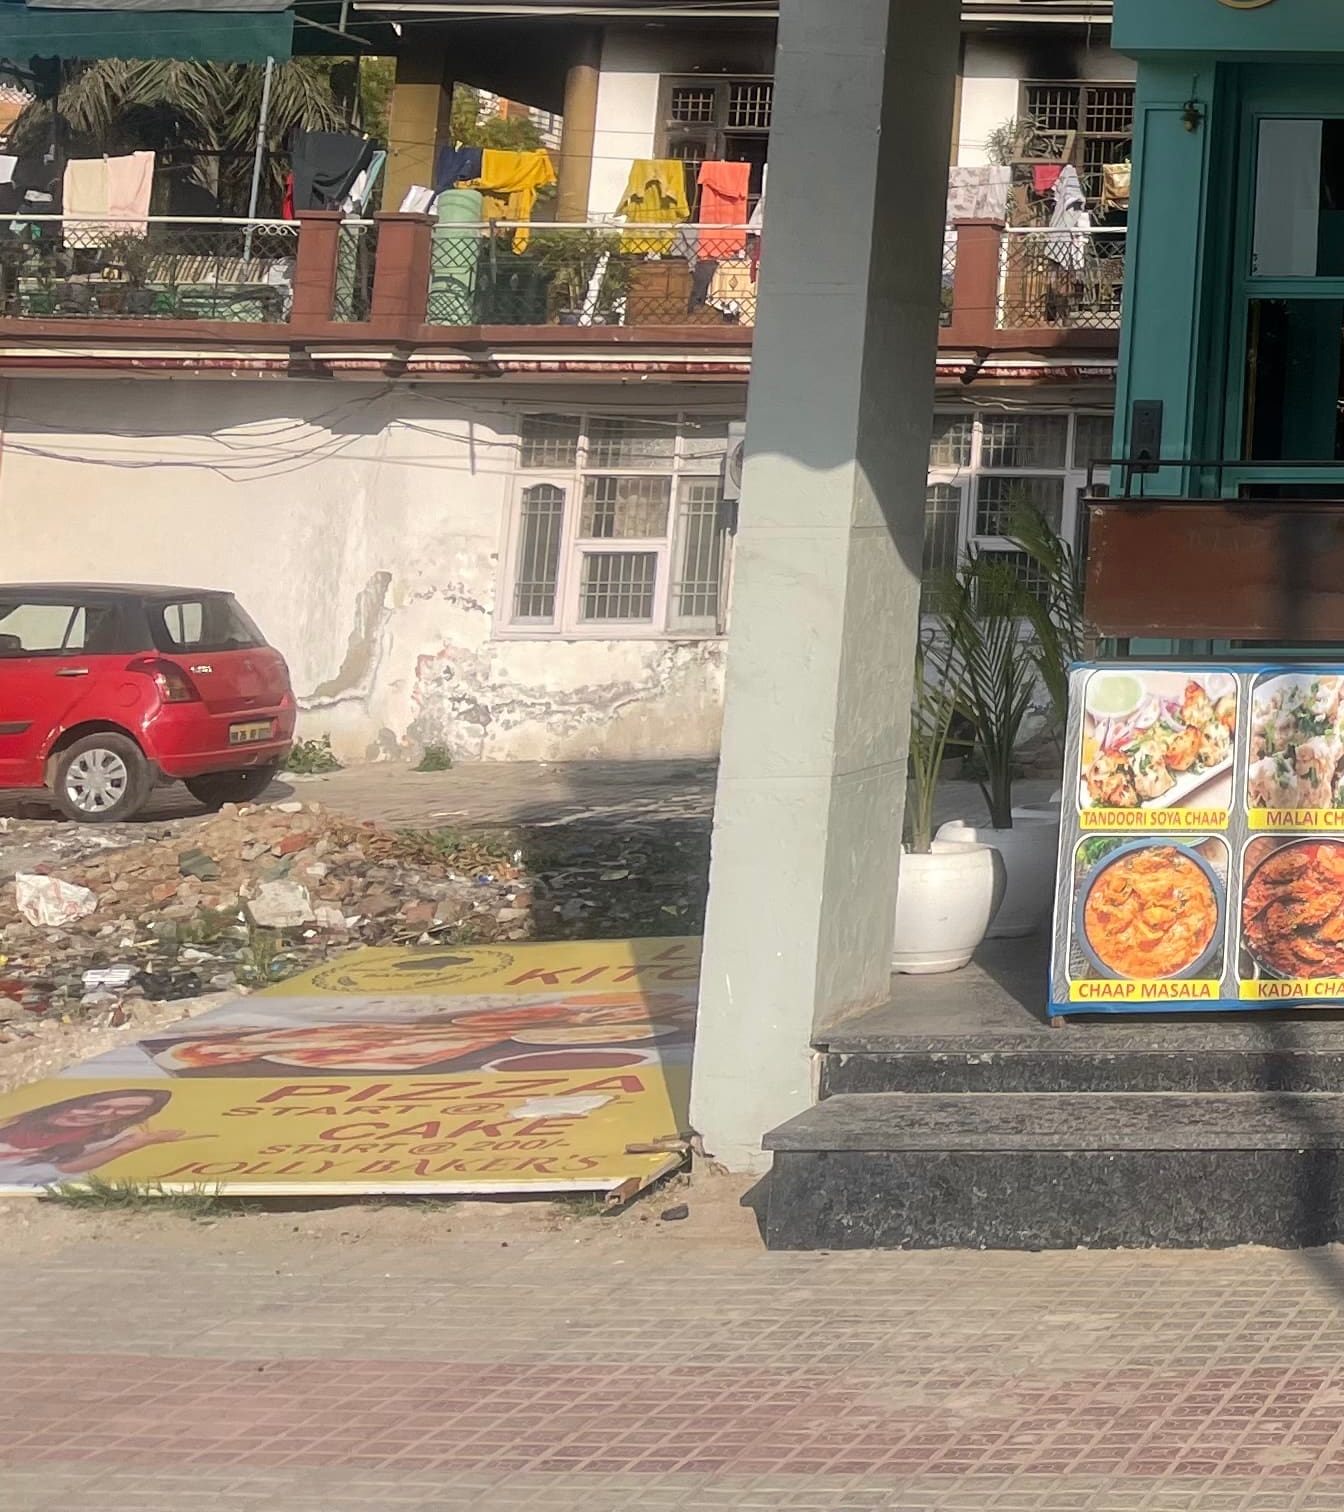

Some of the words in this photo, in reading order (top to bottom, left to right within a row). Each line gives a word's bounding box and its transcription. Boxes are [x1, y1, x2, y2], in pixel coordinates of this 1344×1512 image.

[1083, 811, 1147, 826] TANDOORI
[1150, 811, 1181, 826] SOYA
[1185, 811, 1227, 826] CHAAP
[1266, 810, 1318, 826] MALAI
[1079, 983, 1135, 998] CHAAP
[1141, 983, 1211, 999] MASALA
[1258, 983, 1308, 997] KADAI
[255, 1074, 646, 1104] PIZZA
[221, 1101, 419, 1117] START
[318, 1115, 589, 1141] CAKE
[257, 1142, 403, 1155] START
[160, 1160, 352, 1179] JOLLY
